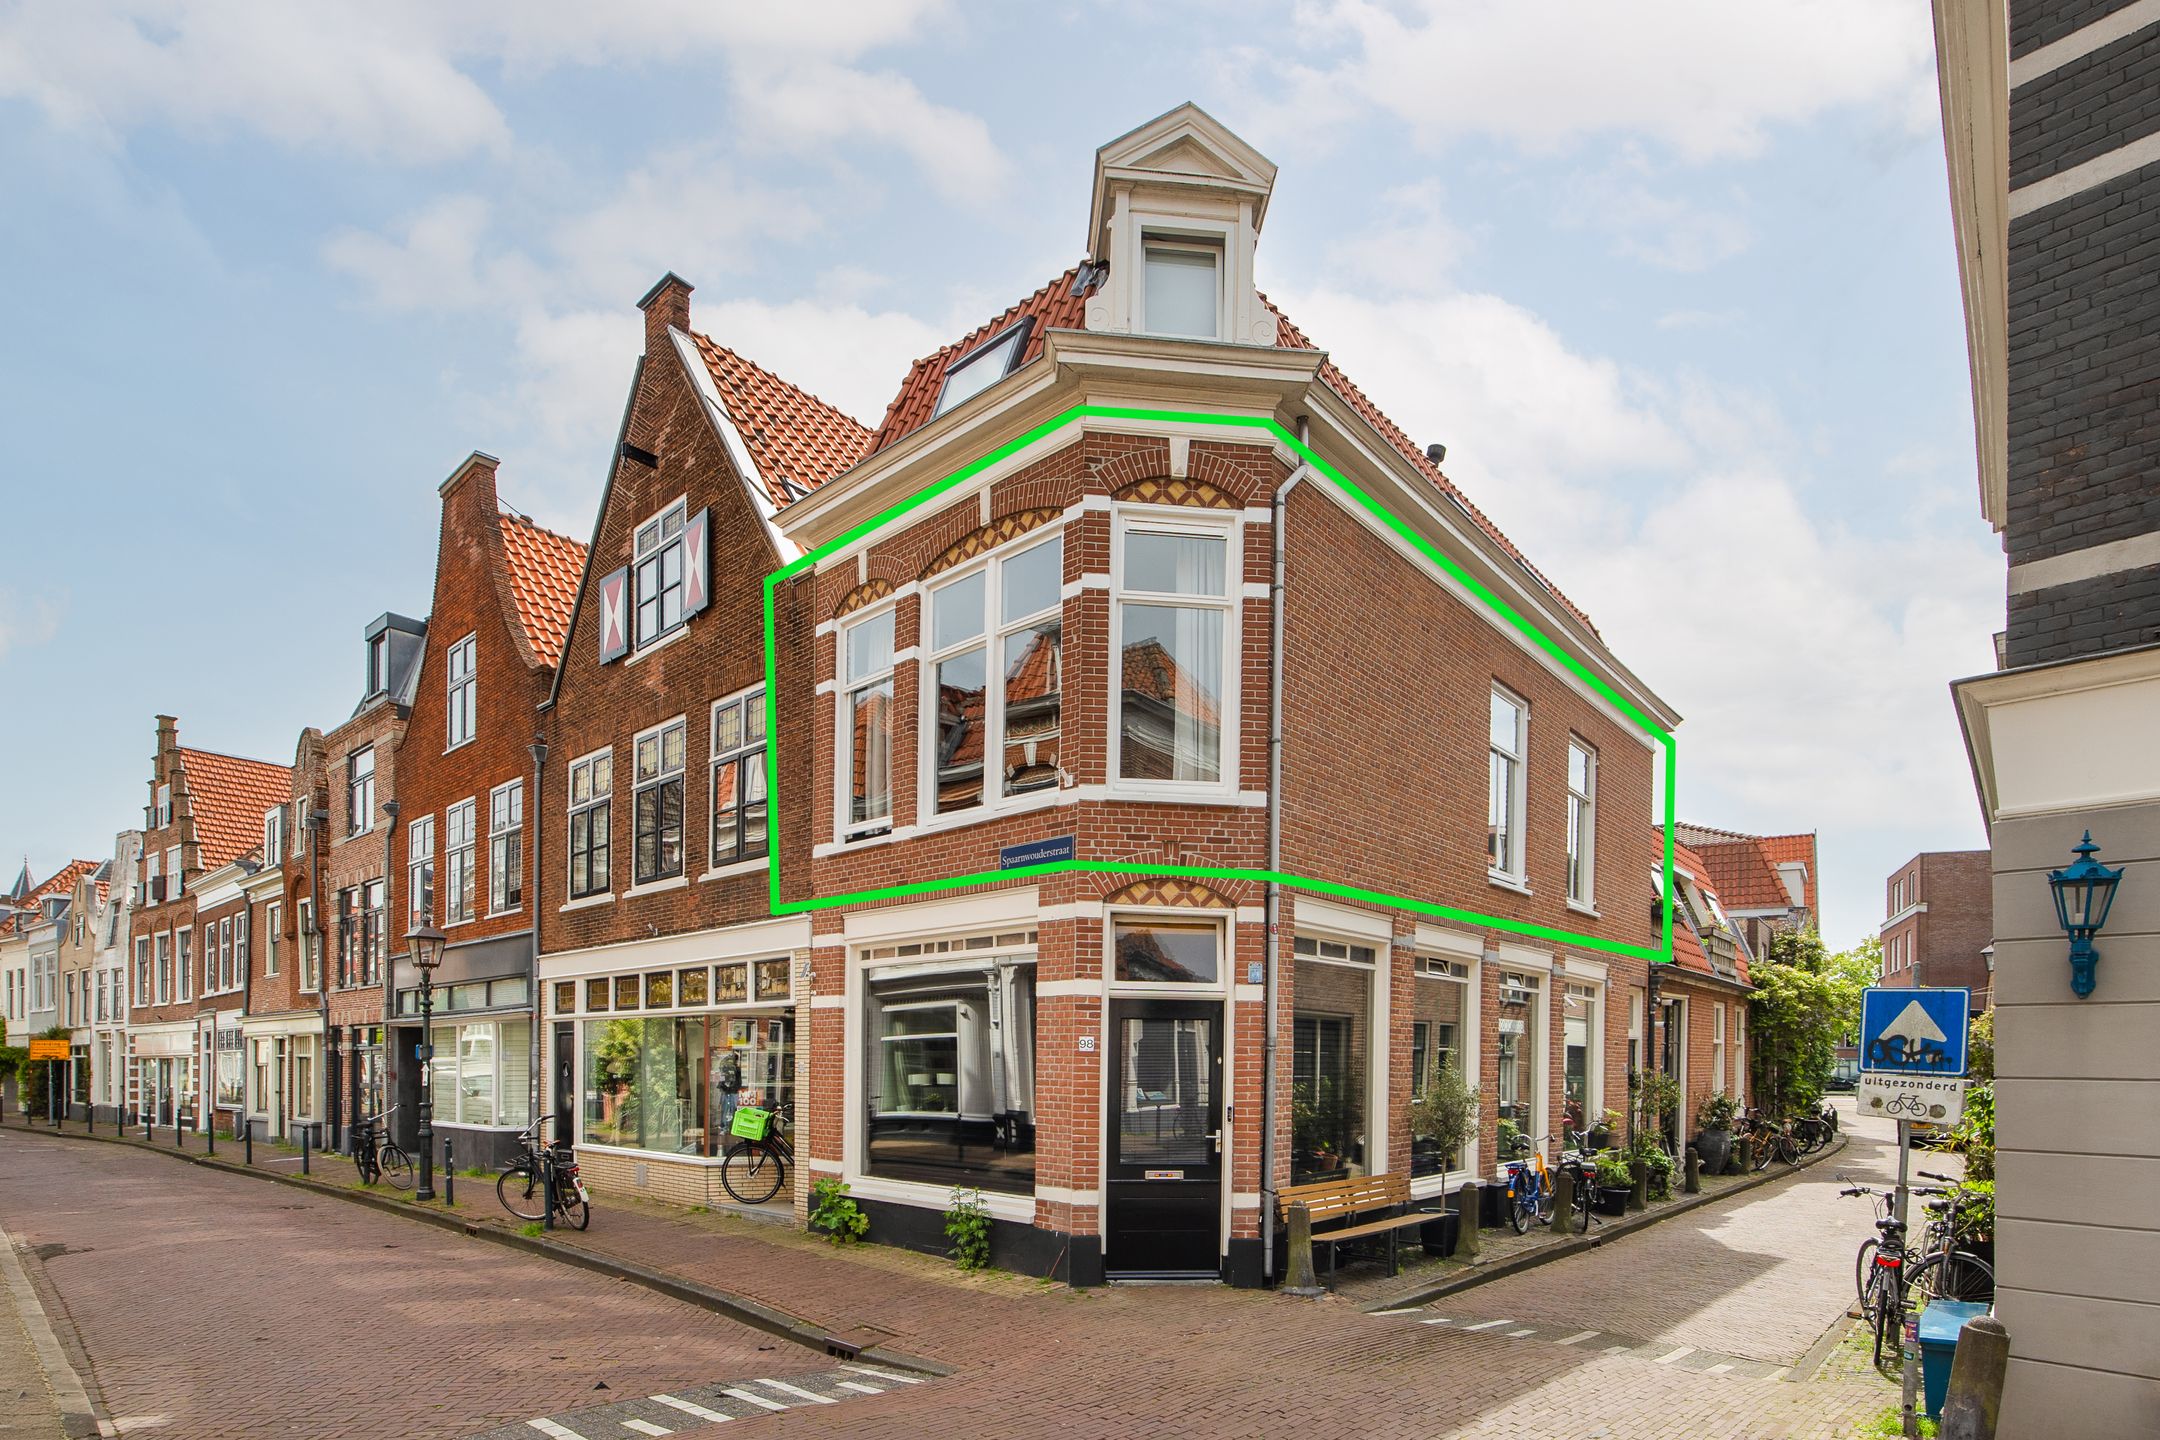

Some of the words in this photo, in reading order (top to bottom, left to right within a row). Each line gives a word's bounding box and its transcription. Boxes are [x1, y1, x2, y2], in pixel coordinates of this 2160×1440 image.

[1002, 847, 1070, 868] Spaarnwouderstraat
[1079, 1039, 1094, 1049] 98
[1864, 1077, 1958, 1092] uitgezonderd
